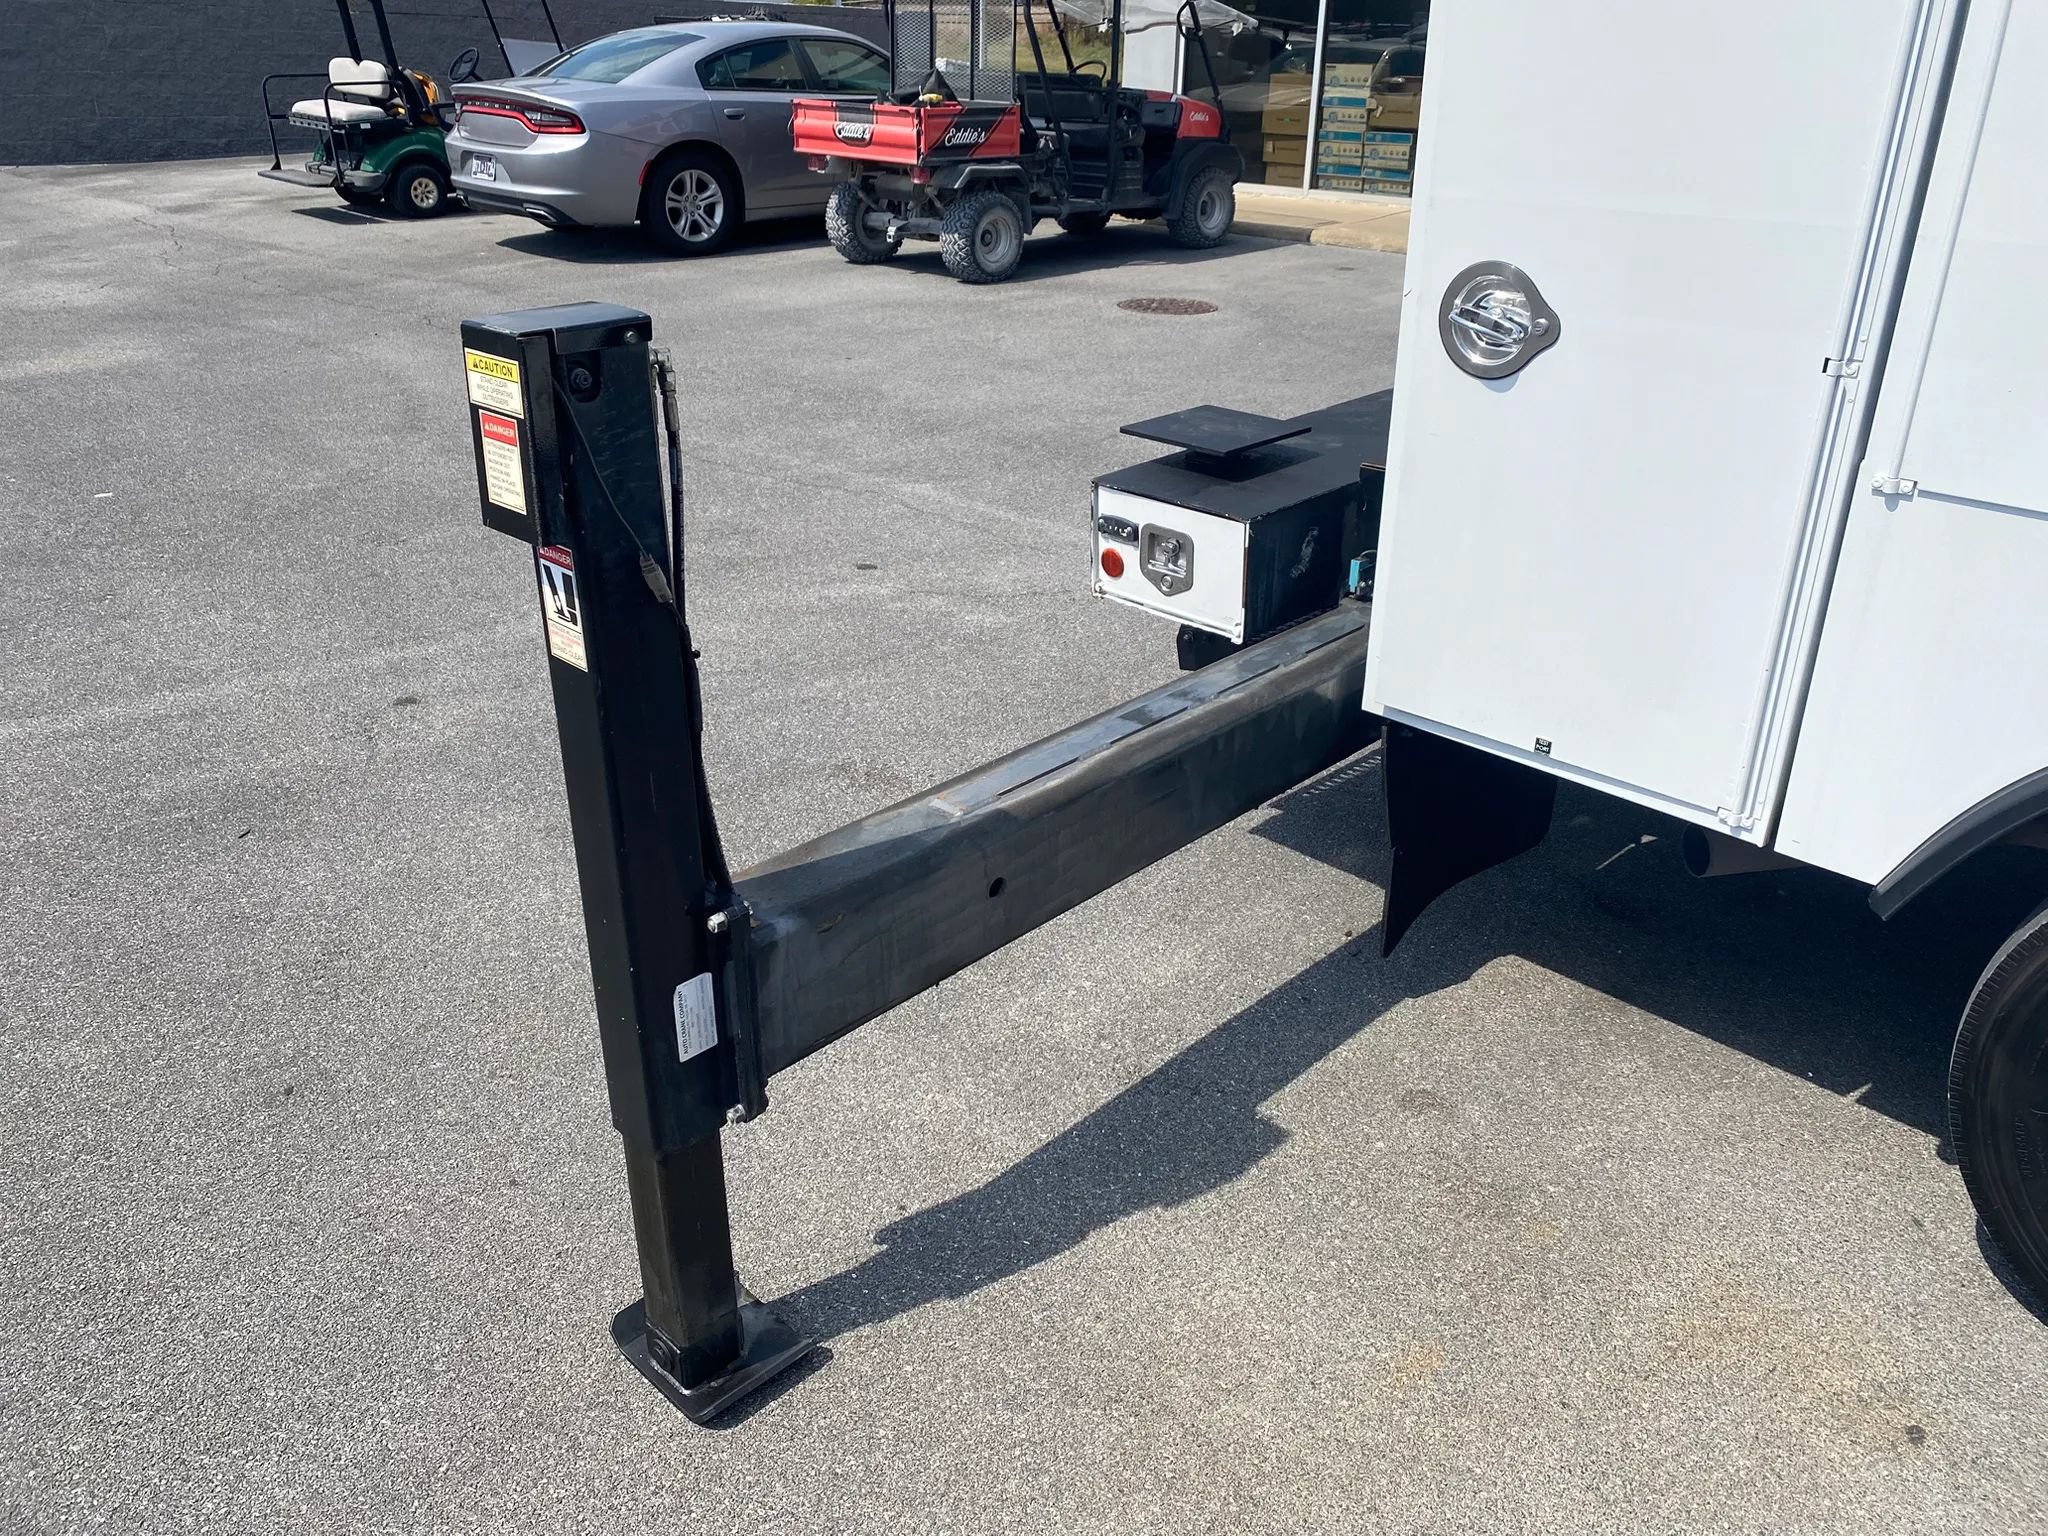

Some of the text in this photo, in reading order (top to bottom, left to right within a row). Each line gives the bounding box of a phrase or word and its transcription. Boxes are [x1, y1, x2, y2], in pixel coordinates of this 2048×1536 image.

[835, 122, 871, 139] Eddie's
[945, 128, 986, 146] Eddie's
[478, 358, 513, 378] CAUTION
[489, 424, 515, 437] DANGER
[544, 547, 571, 564] DANGER
[1536, 744, 1549, 752] PORT
[677, 990, 685, 1018] COMPANY
[681, 1039, 689, 1055] AUTO
